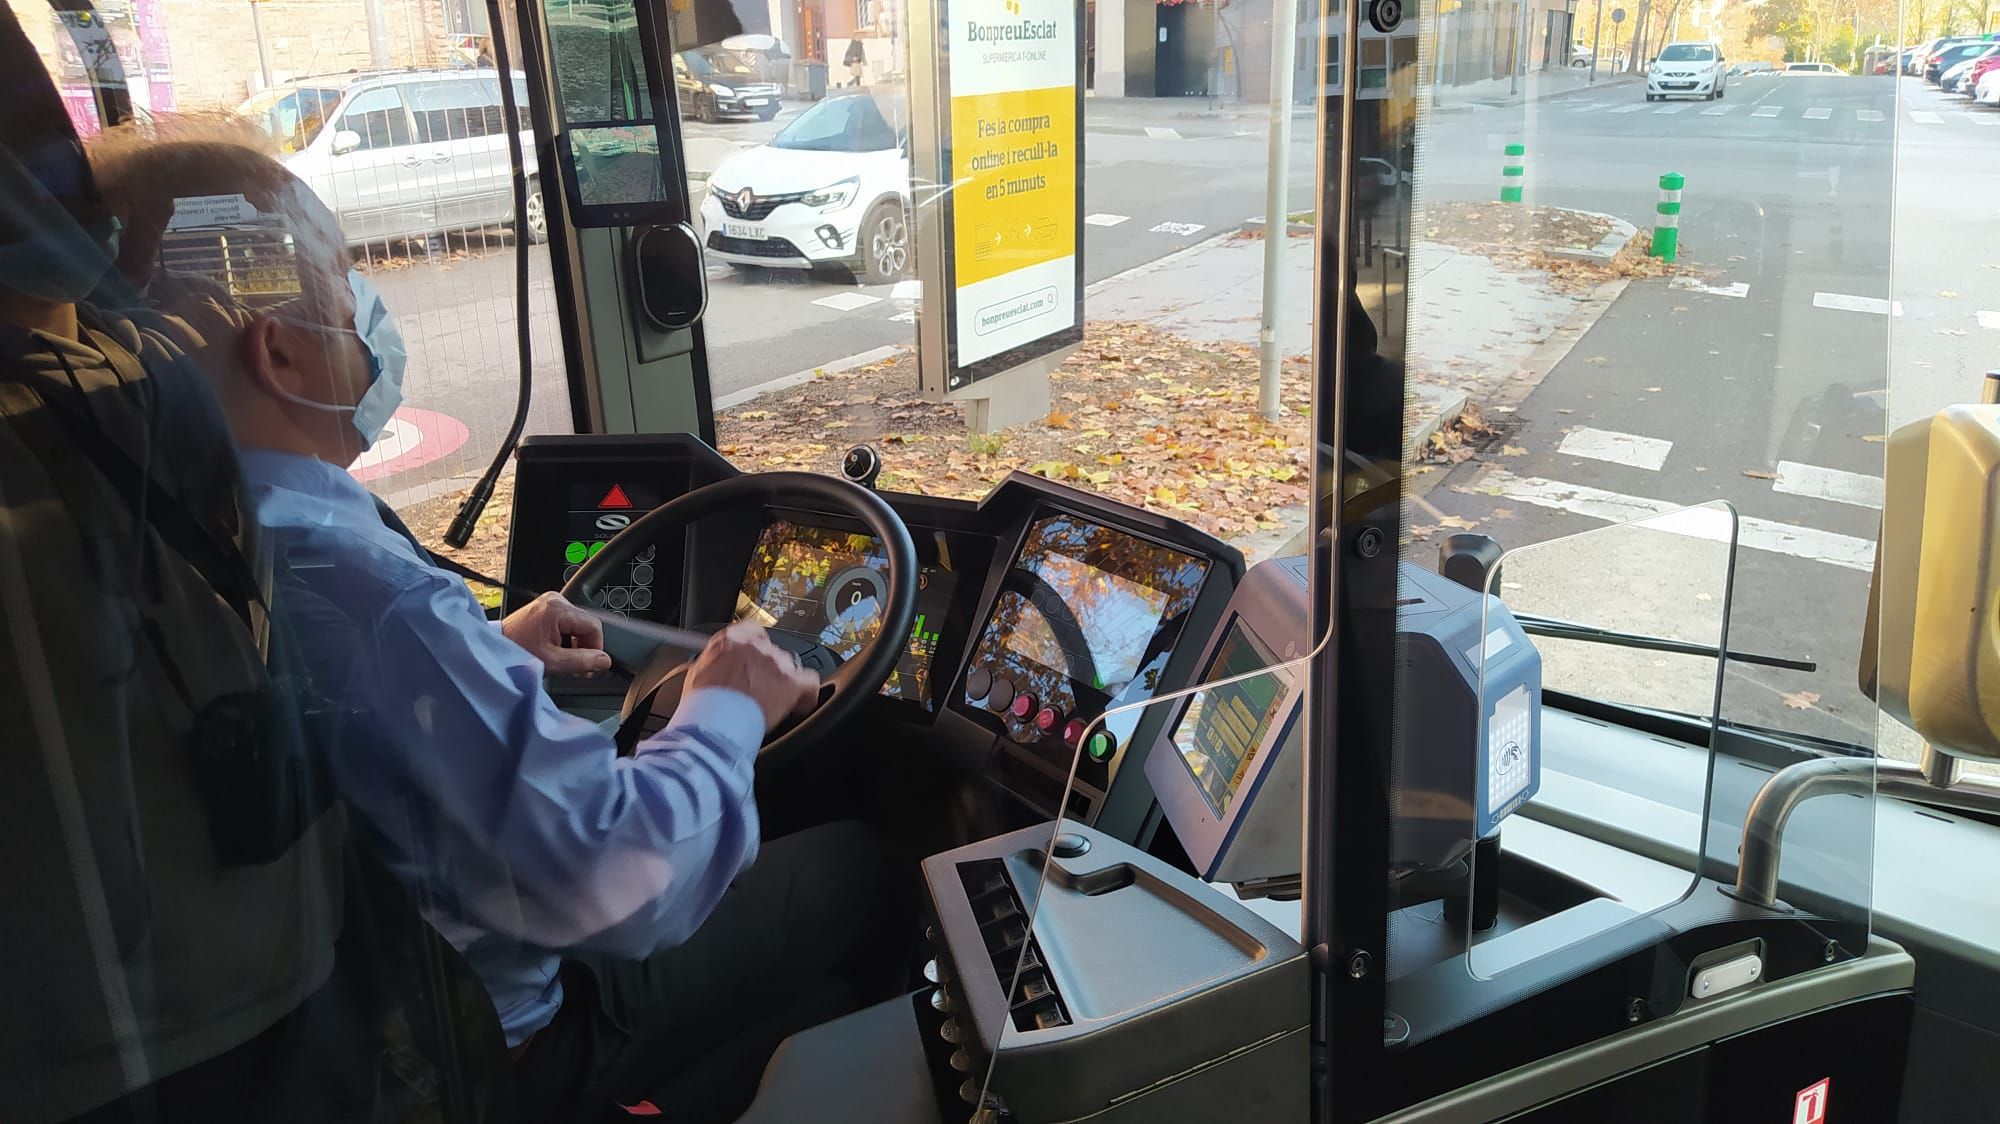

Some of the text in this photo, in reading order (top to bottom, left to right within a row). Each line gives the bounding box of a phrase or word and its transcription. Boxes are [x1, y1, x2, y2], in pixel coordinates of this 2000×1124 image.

[967, 20, 1056, 46] BonpreuEsclat
[978, 115, 1050, 138] Fes la compra
[972, 149, 1006, 171] online
[1007, 146, 1011, 164] i
[986, 173, 1046, 200] en 5 minuts
[981, 299, 1044, 327] bonpreuesclat.com
[851, 590, 862, 605] 0
